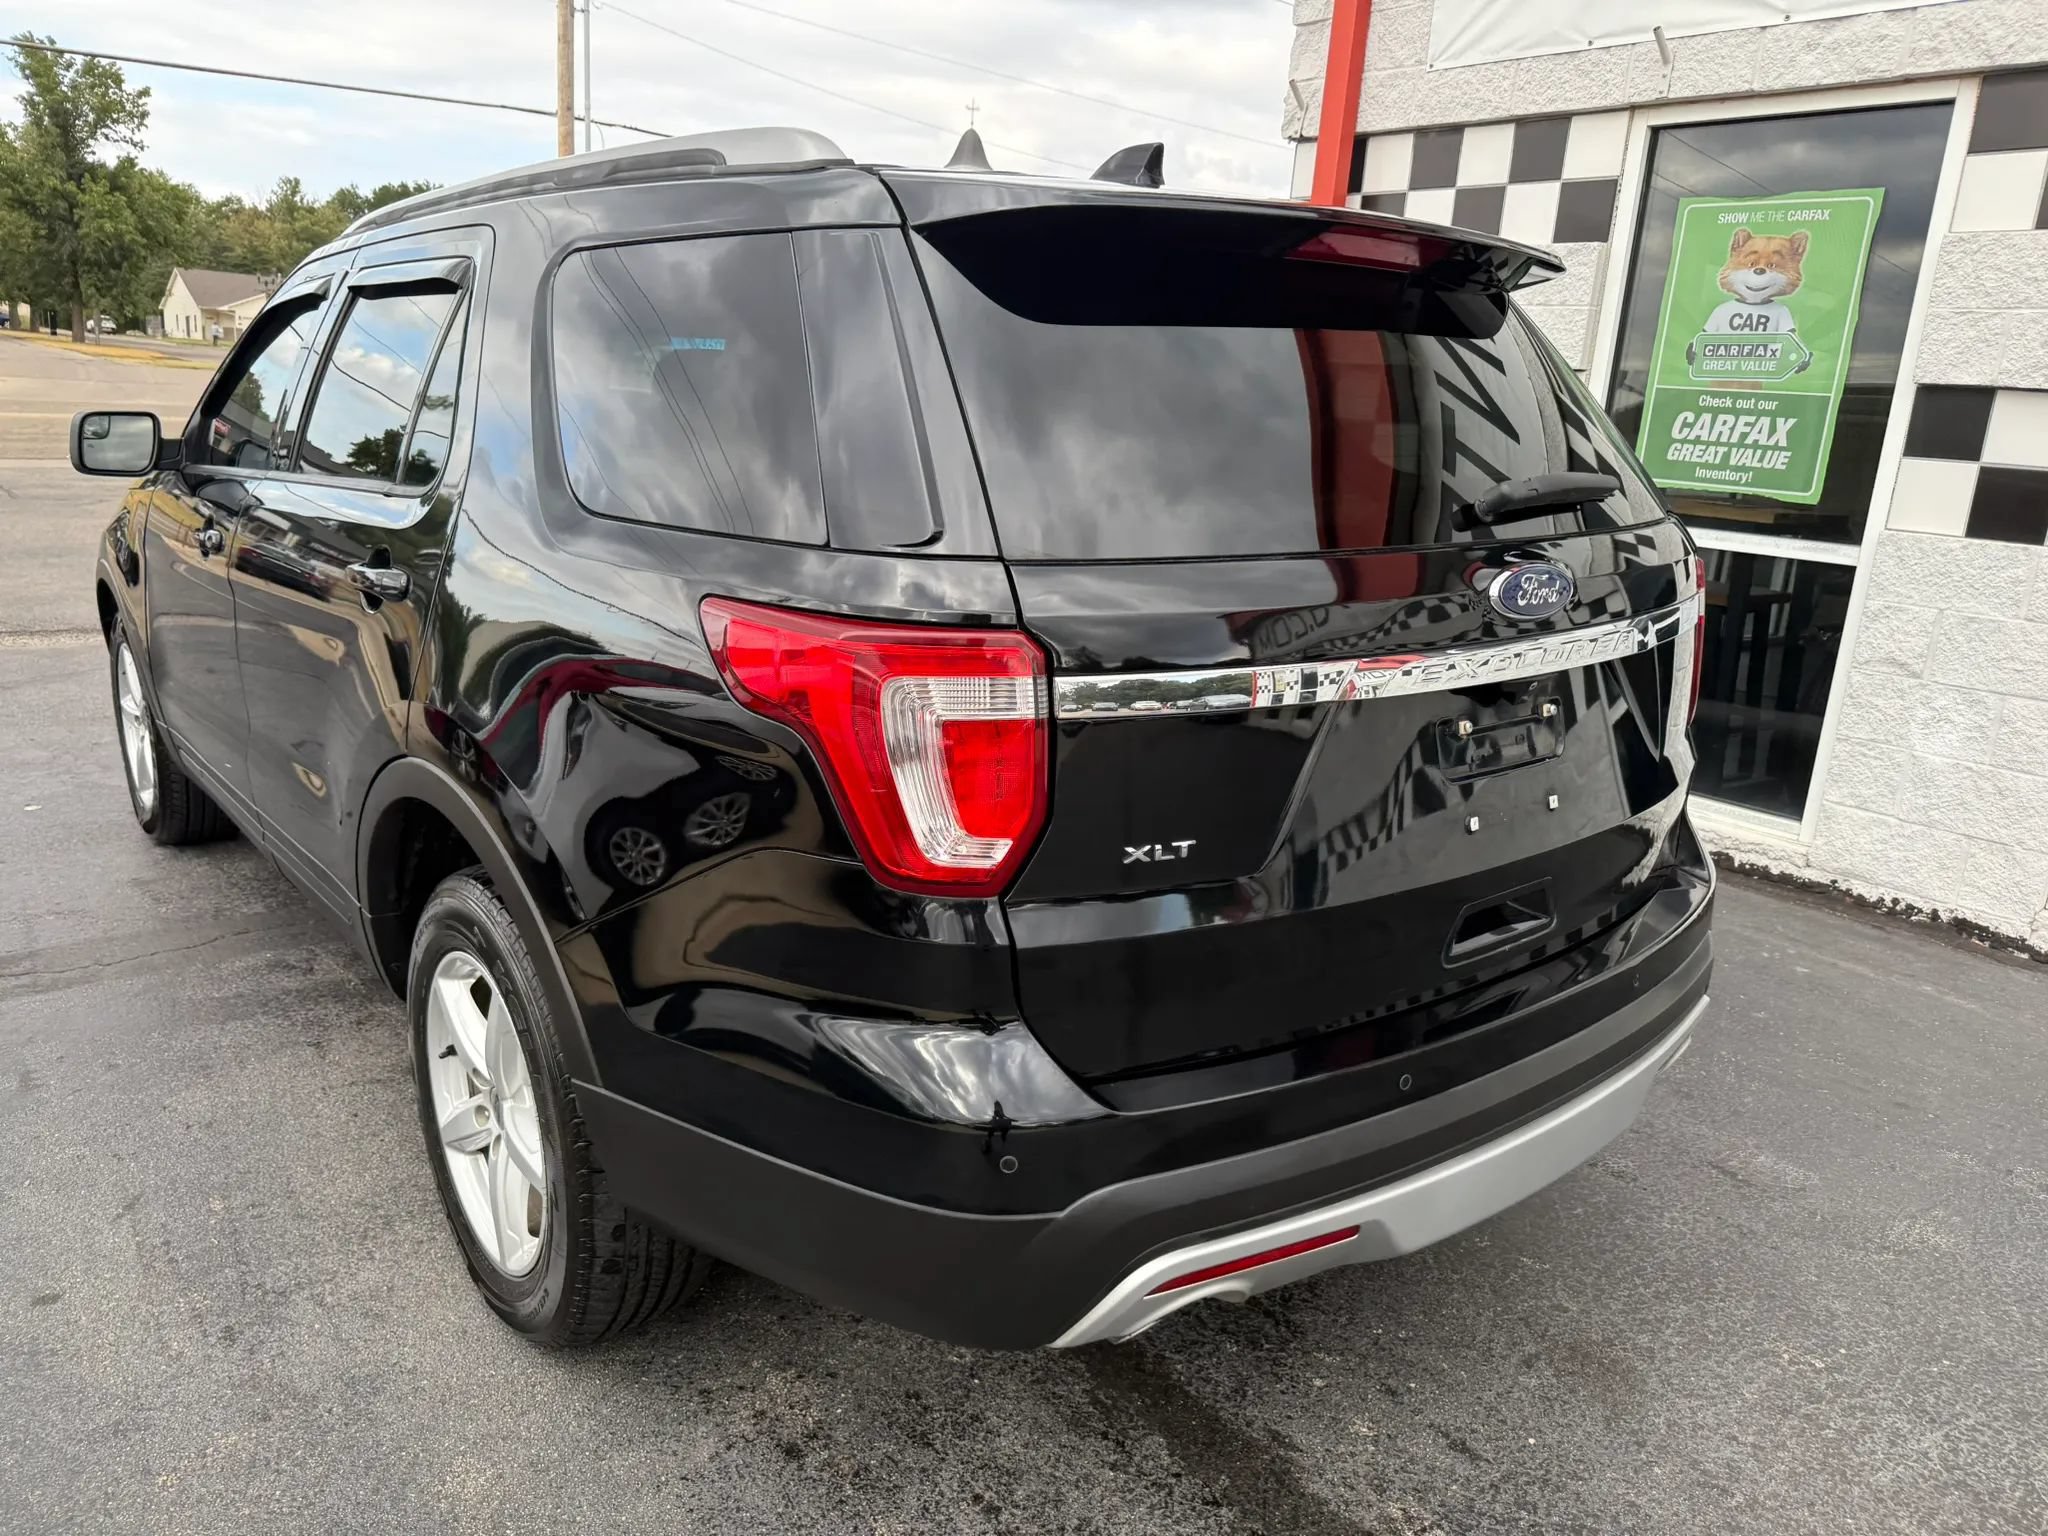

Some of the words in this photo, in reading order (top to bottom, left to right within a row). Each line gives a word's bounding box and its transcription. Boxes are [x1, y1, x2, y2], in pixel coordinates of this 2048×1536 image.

[1717, 212, 1749, 224] SHOW
[1750, 211, 1766, 223] ME
[1767, 210, 1786, 222] THE
[1787, 208, 1833, 221] CARFAX
[1729, 313, 1770, 332] CAR
[1703, 343, 1781, 358] CARFAX
[1703, 360, 1738, 371] GREAT
[1740, 360, 1777, 371] VALUE
[1698, 394, 1733, 408] Check
[1735, 397, 1755, 410] out
[1757, 399, 1779, 411] our
[1671, 411, 1798, 447] CARFAX
[1666, 443, 1729, 465] GREAT
[1728, 446, 1793, 470] VALUE
[1695, 466, 1753, 484] Inventory!
[1517, 573, 1561, 606] Ford
[1122, 839, 1197, 864] XLT
